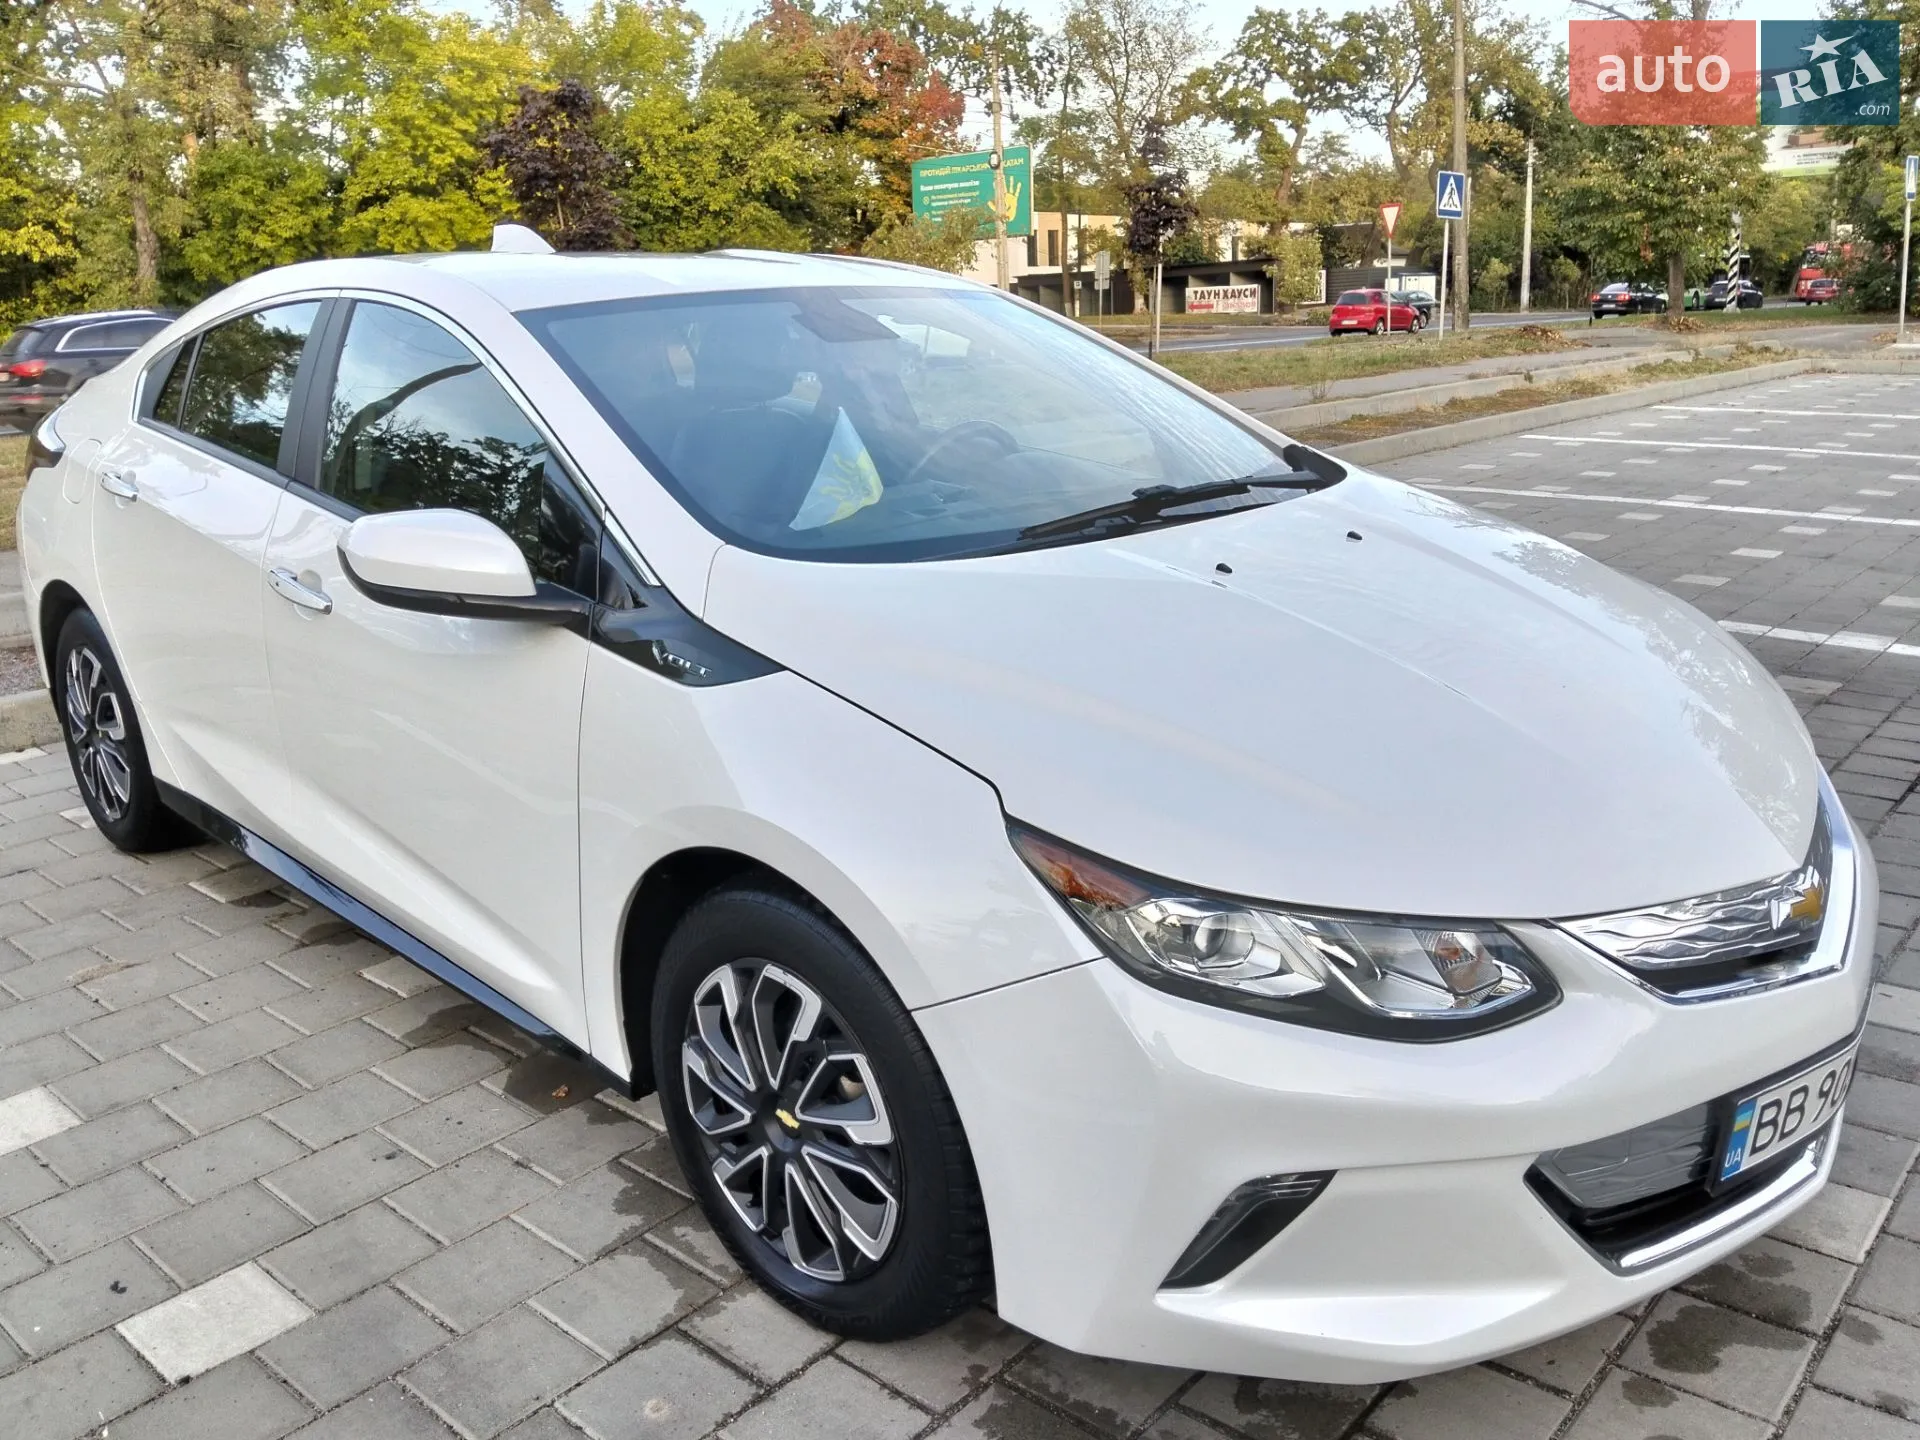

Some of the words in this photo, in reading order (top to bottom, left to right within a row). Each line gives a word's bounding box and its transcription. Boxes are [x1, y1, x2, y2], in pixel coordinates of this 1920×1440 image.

[1749, 1084, 1809, 1157] BB
[1811, 1056, 1852, 1123] 90
[1724, 1148, 1741, 1168] UA
